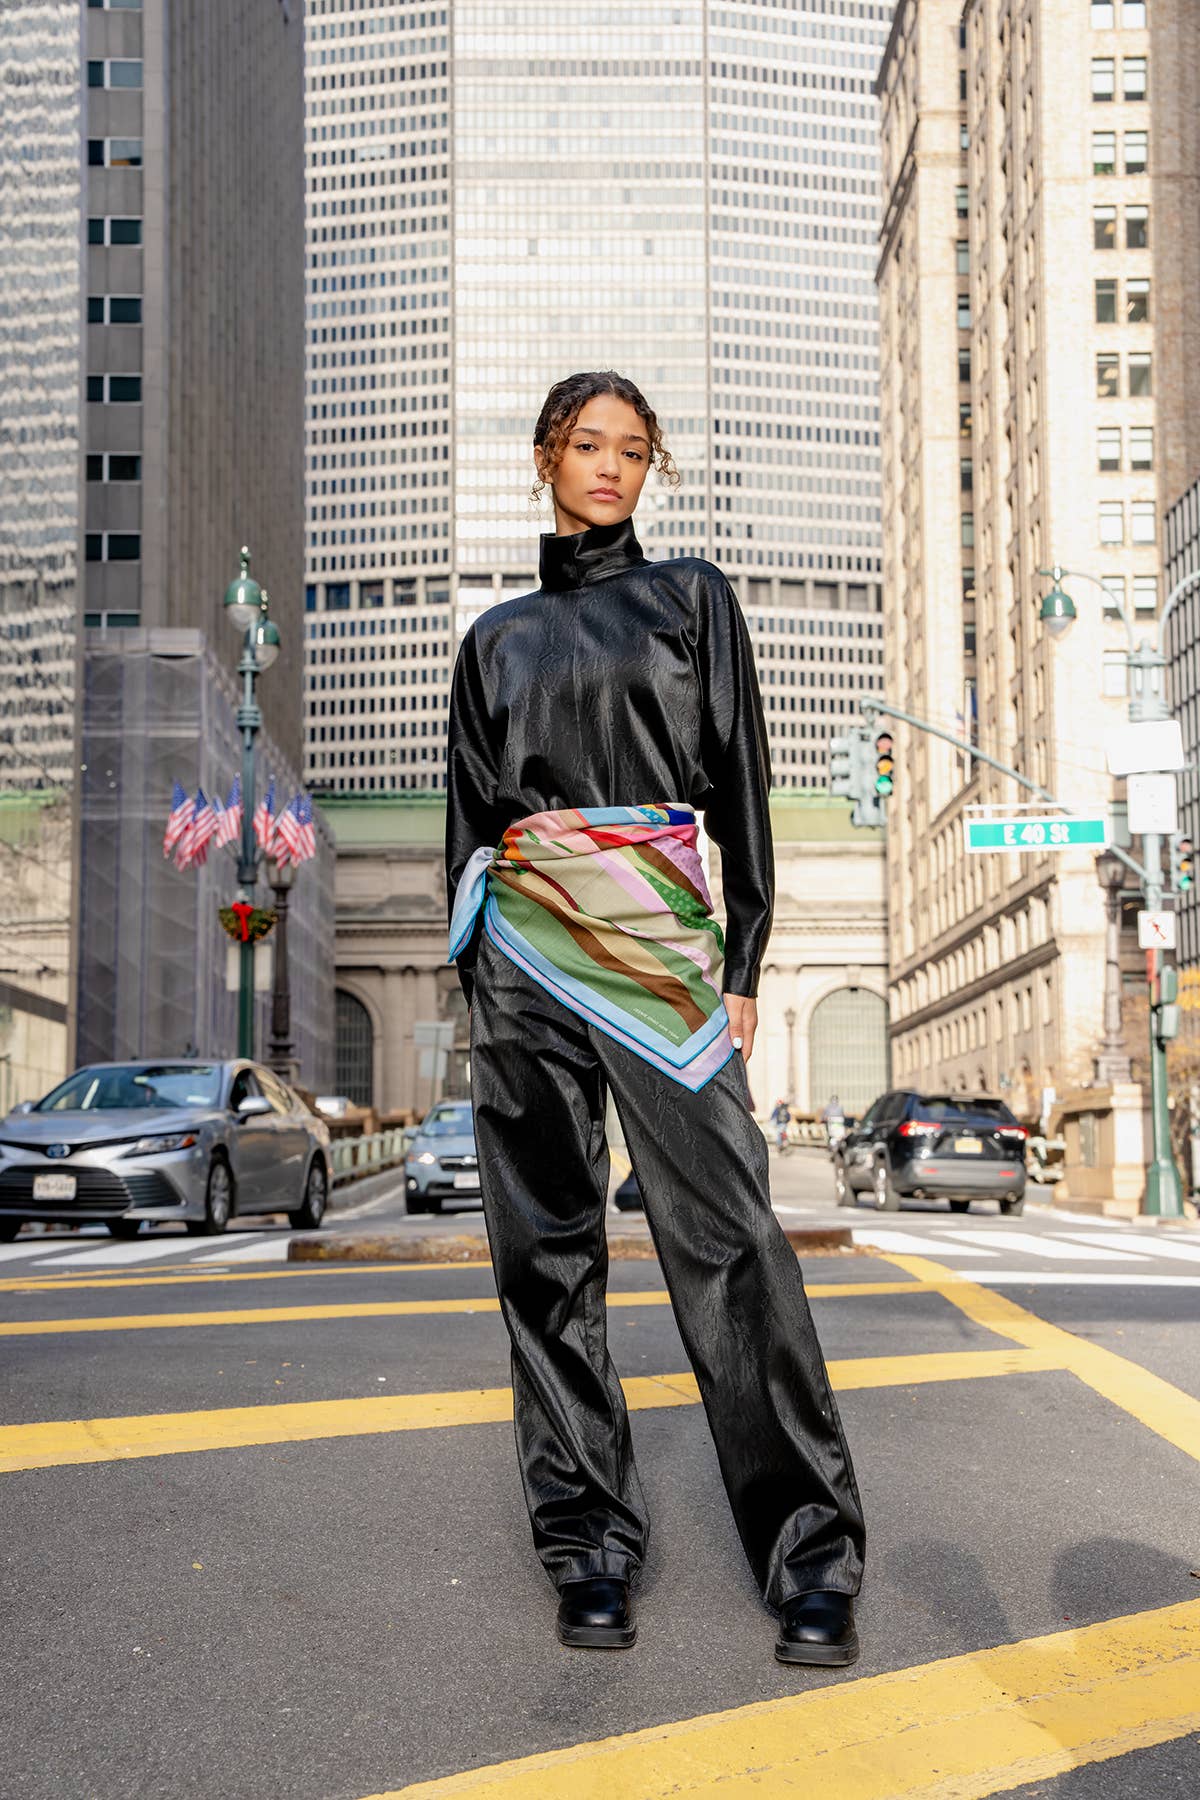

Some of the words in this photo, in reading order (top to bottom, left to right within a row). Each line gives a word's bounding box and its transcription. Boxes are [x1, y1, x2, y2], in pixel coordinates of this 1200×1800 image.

[1003, 825, 1017, 845] E
[1020, 823, 1046, 844] 40
[1050, 823, 1071, 843] St
